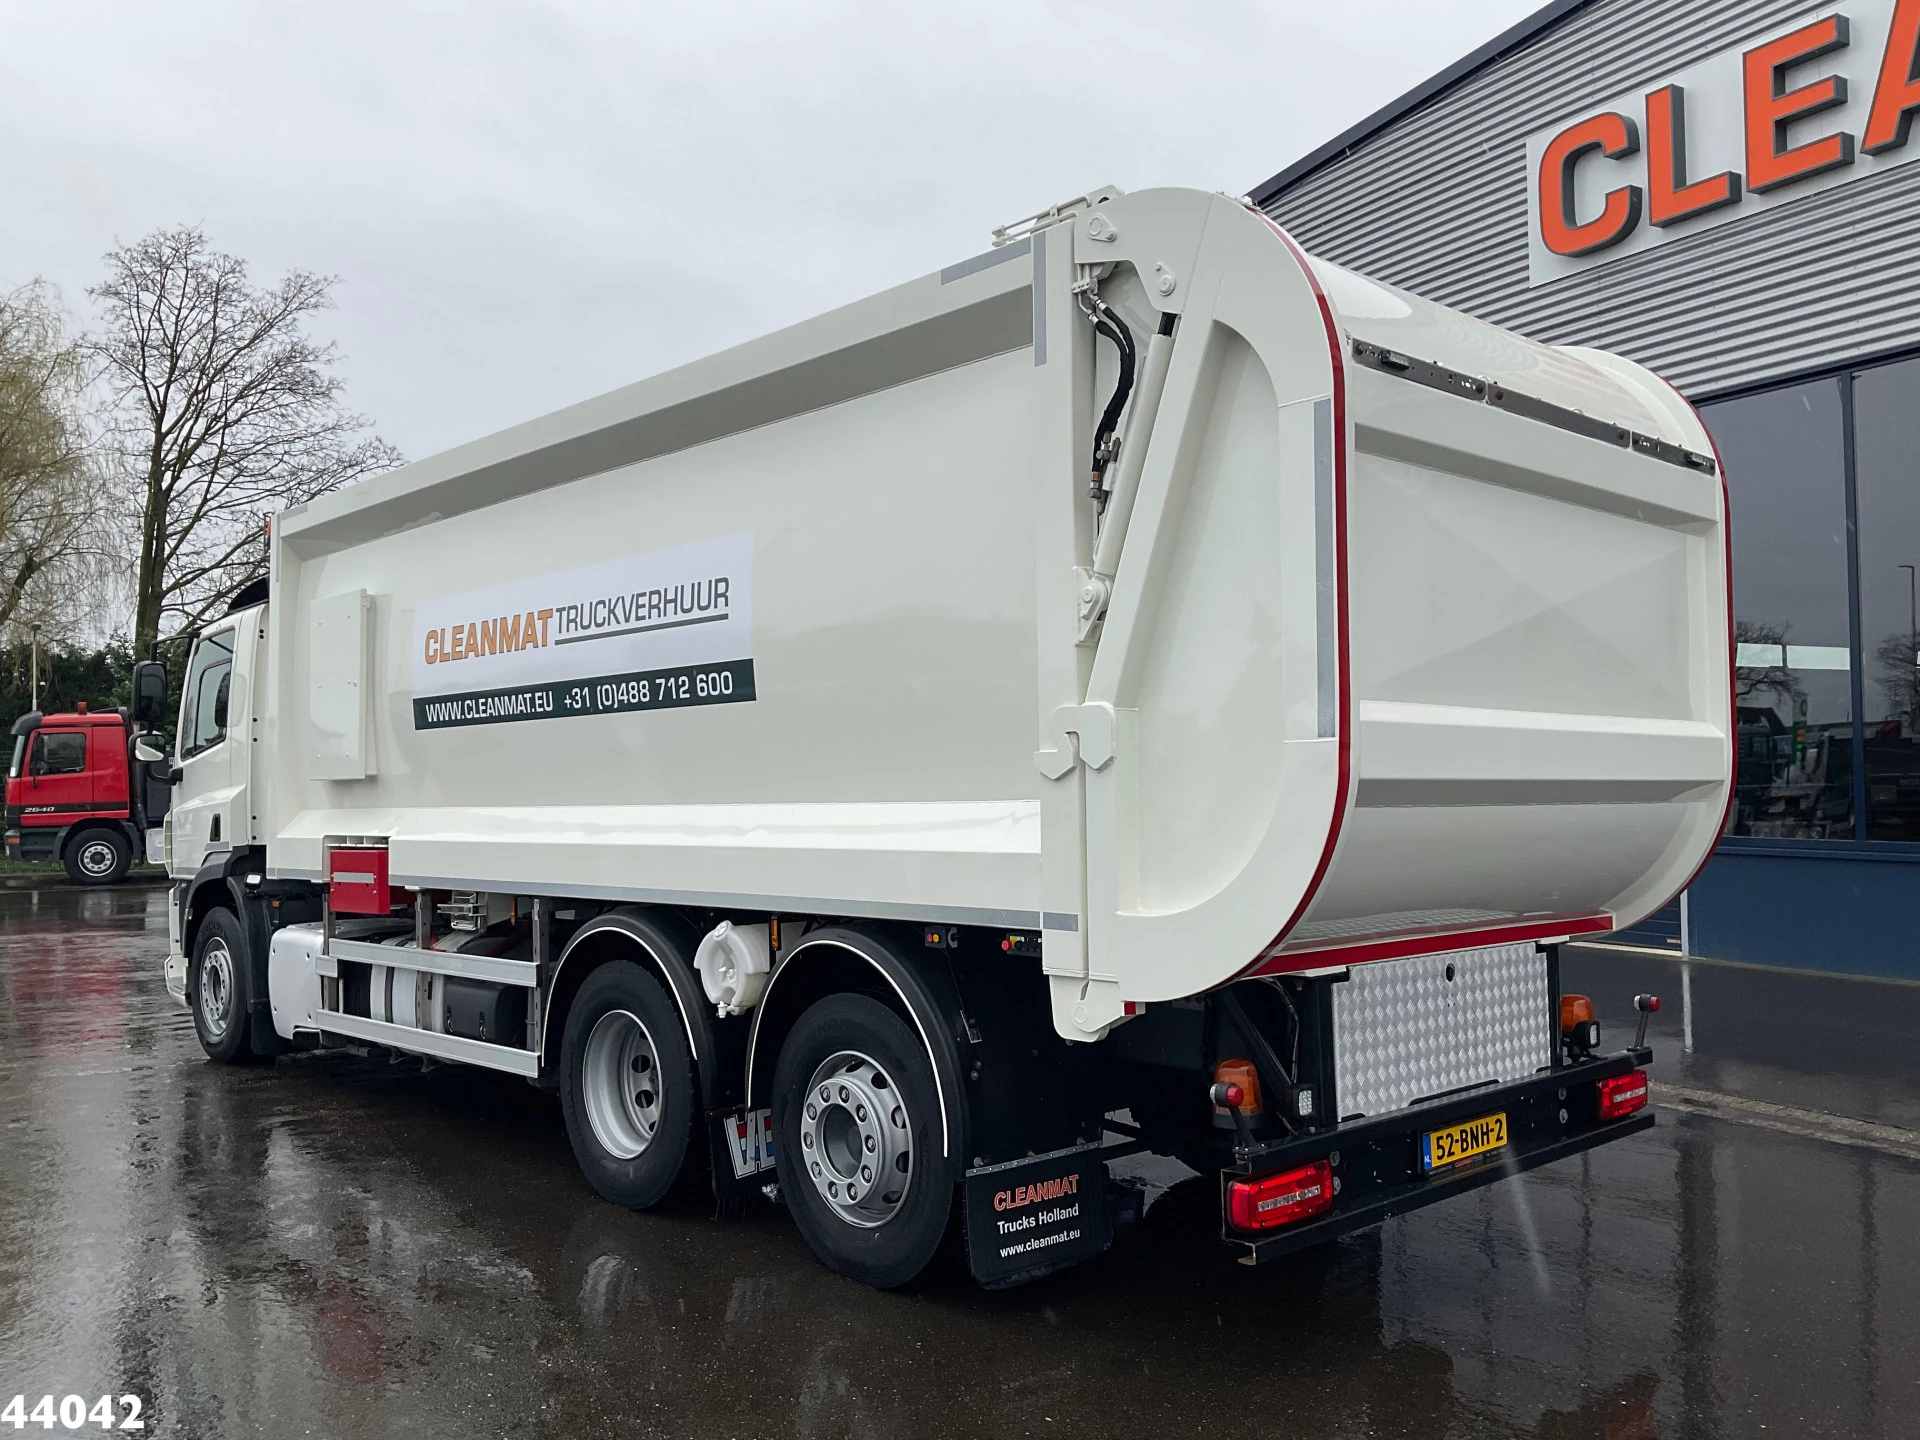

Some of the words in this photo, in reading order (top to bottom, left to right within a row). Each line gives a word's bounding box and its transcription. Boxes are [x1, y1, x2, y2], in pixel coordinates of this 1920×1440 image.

[424, 608, 553, 665] CLEANMAT
[556, 577, 729, 634] TRUCKVERHUUR
[426, 691, 553, 722] WWW.CLEANMAT.EU
[564, 687, 590, 708] +31
[597, 681, 650, 710] (0)488
[656, 676, 690, 700] 712
[696, 671, 733, 697] 600
[1435, 1118, 1504, 1160] 52-BNH-2
[1424, 1155, 1431, 1163] NL
[994, 1174, 1079, 1211] CLEANMAT
[997, 1216, 1036, 1235] Trucks
[1039, 1203, 1079, 1225] Holland
[1000, 1229, 1080, 1258] www.cleanmat.eu
